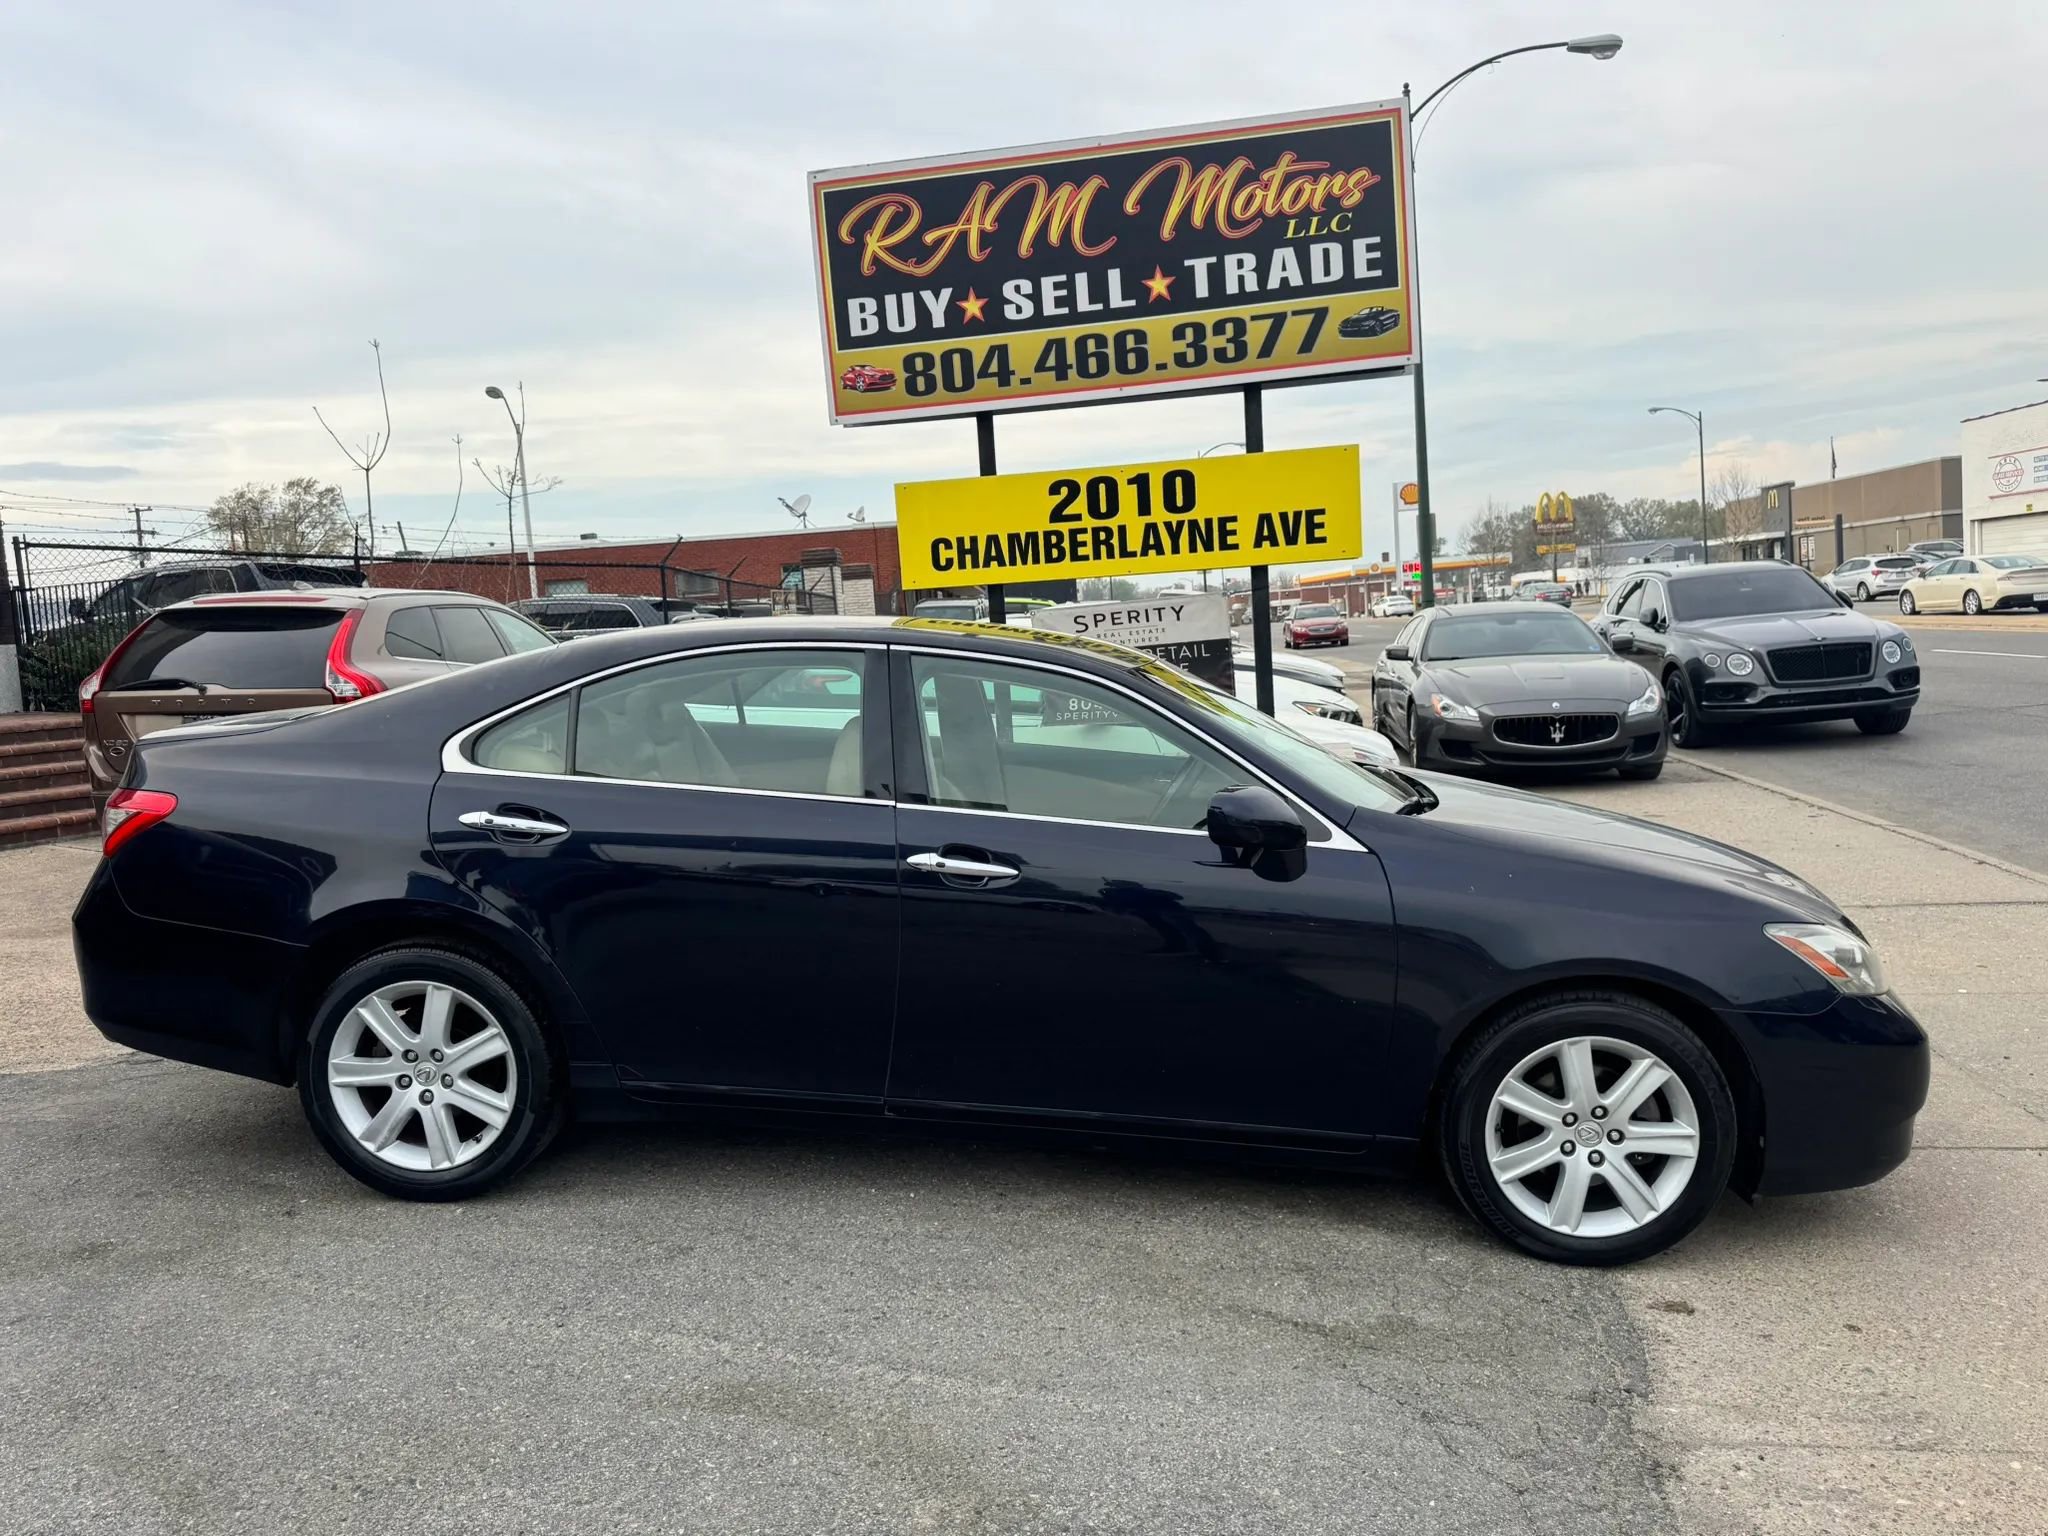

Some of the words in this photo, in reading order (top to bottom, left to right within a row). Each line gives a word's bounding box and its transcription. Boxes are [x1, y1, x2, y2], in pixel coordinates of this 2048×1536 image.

[838, 175, 1117, 277] RAM
[1123, 151, 1380, 241] Motors
[1284, 212, 1353, 240] LLC
[847, 288, 953, 337] BUY
[1002, 268, 1136, 321] SELL
[1184, 236, 1383, 298] TRADE
[902, 307, 1330, 397] 804.466.3377
[1048, 469, 1196, 524] 2010
[930, 515, 1239, 572] CHAMBERLAYNE
[1253, 508, 1327, 549] AVE
[1073, 605, 1184, 633] SPERITY
[1096, 631, 1121, 639] REAL
[1129, 628, 1166, 636] ESTATE
